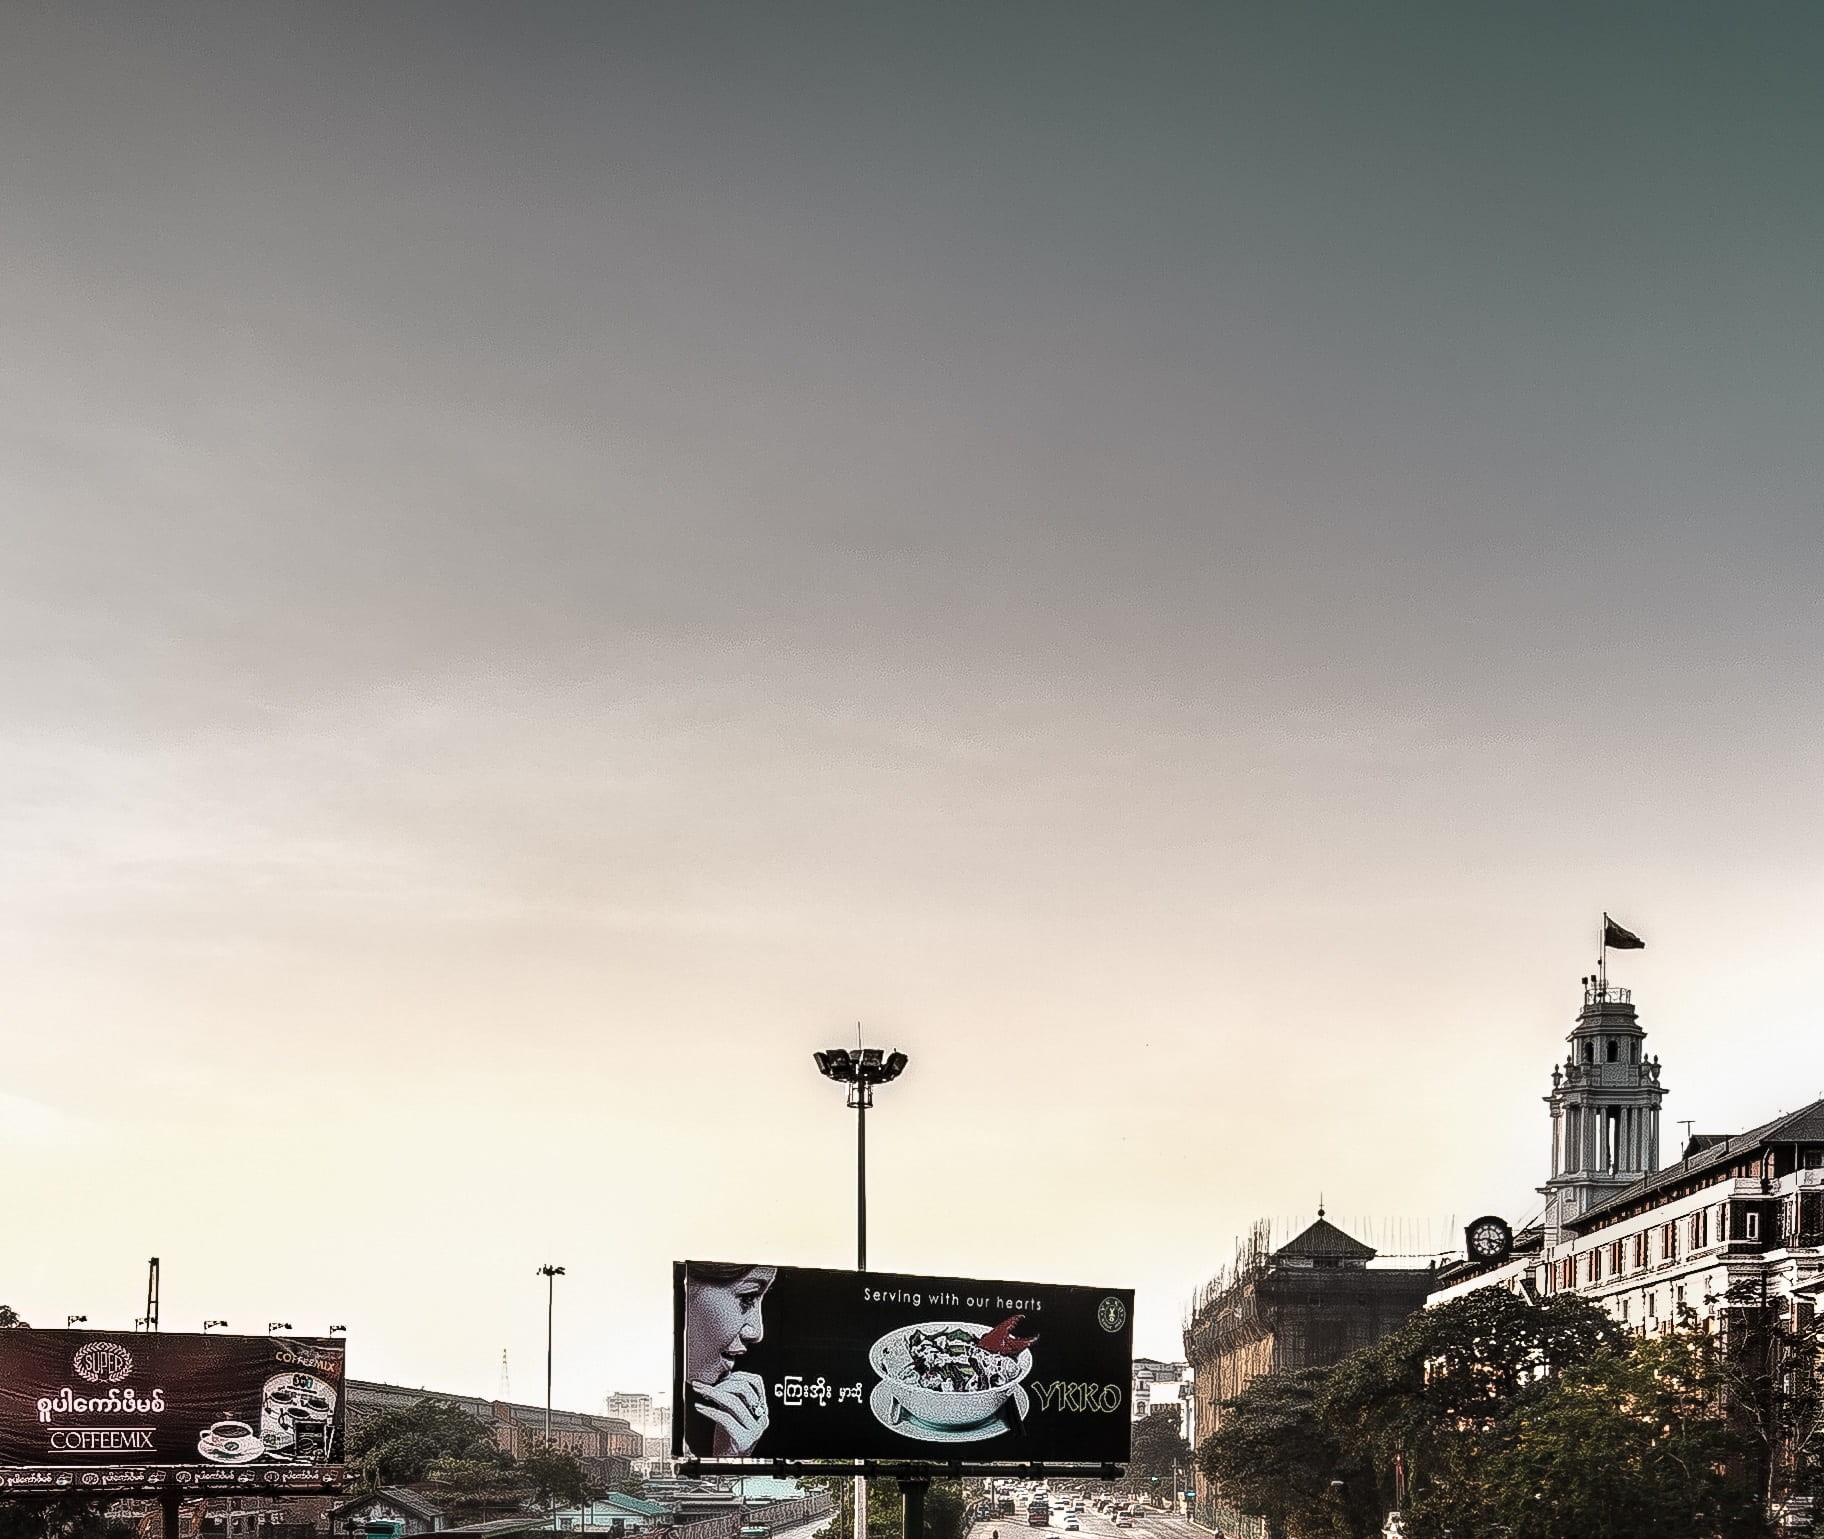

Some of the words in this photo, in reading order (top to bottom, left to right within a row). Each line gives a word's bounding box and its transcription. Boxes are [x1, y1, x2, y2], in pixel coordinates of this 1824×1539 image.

[864, 1287, 921, 1307] Serving
[928, 1292, 959, 1306] with
[966, 1295, 990, 1308] our
[996, 1295, 1043, 1311] hearts
[85, 1351, 123, 1374] SUPER
[275, 1351, 335, 1372] COFFEEMIX
[774, 1375, 832, 1406] ကြေးအိုး
[1031, 1380, 1122, 1413] YKKO
[50, 1431, 154, 1449] COFFEEMIX
